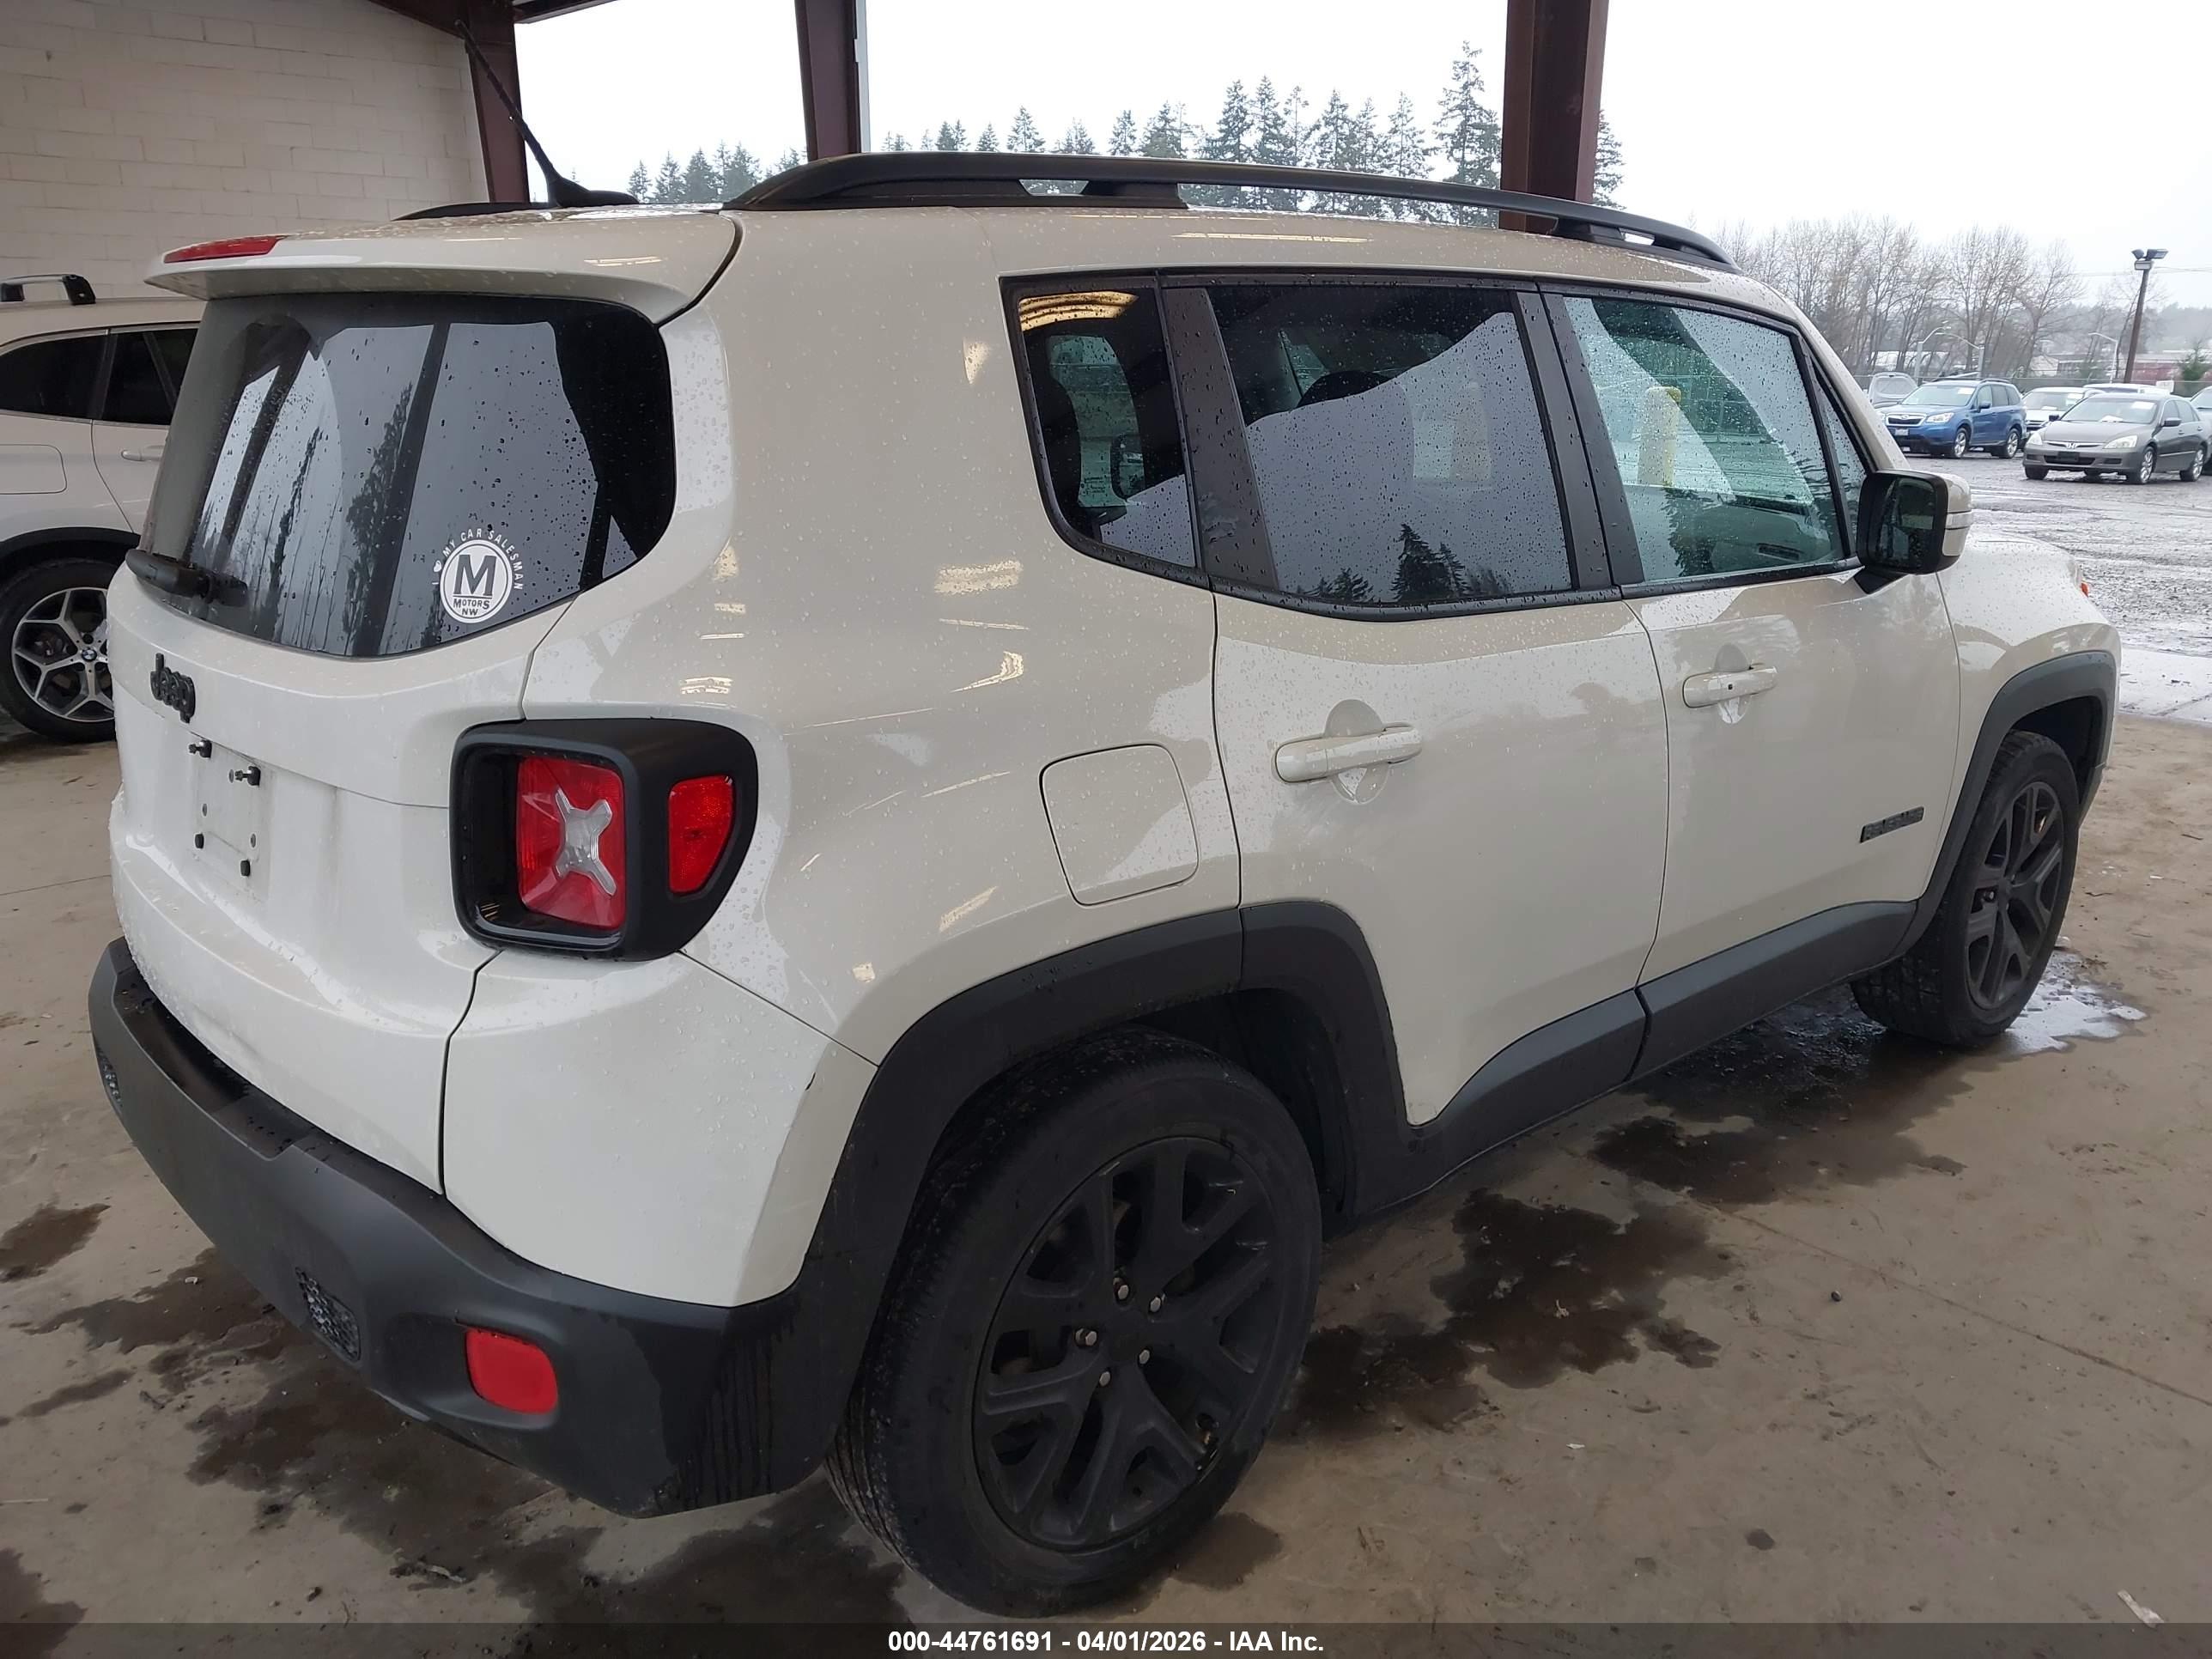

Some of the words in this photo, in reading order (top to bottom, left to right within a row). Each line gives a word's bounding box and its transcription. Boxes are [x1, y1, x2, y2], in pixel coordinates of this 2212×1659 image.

[442, 538, 456, 557] MY
[460, 528, 482, 541] CAR
[488, 530, 523, 590] SALESMAN
[453, 554, 496, 596] M
[453, 599, 489, 609] MOTORS
[149, 653, 196, 724] Jeep
